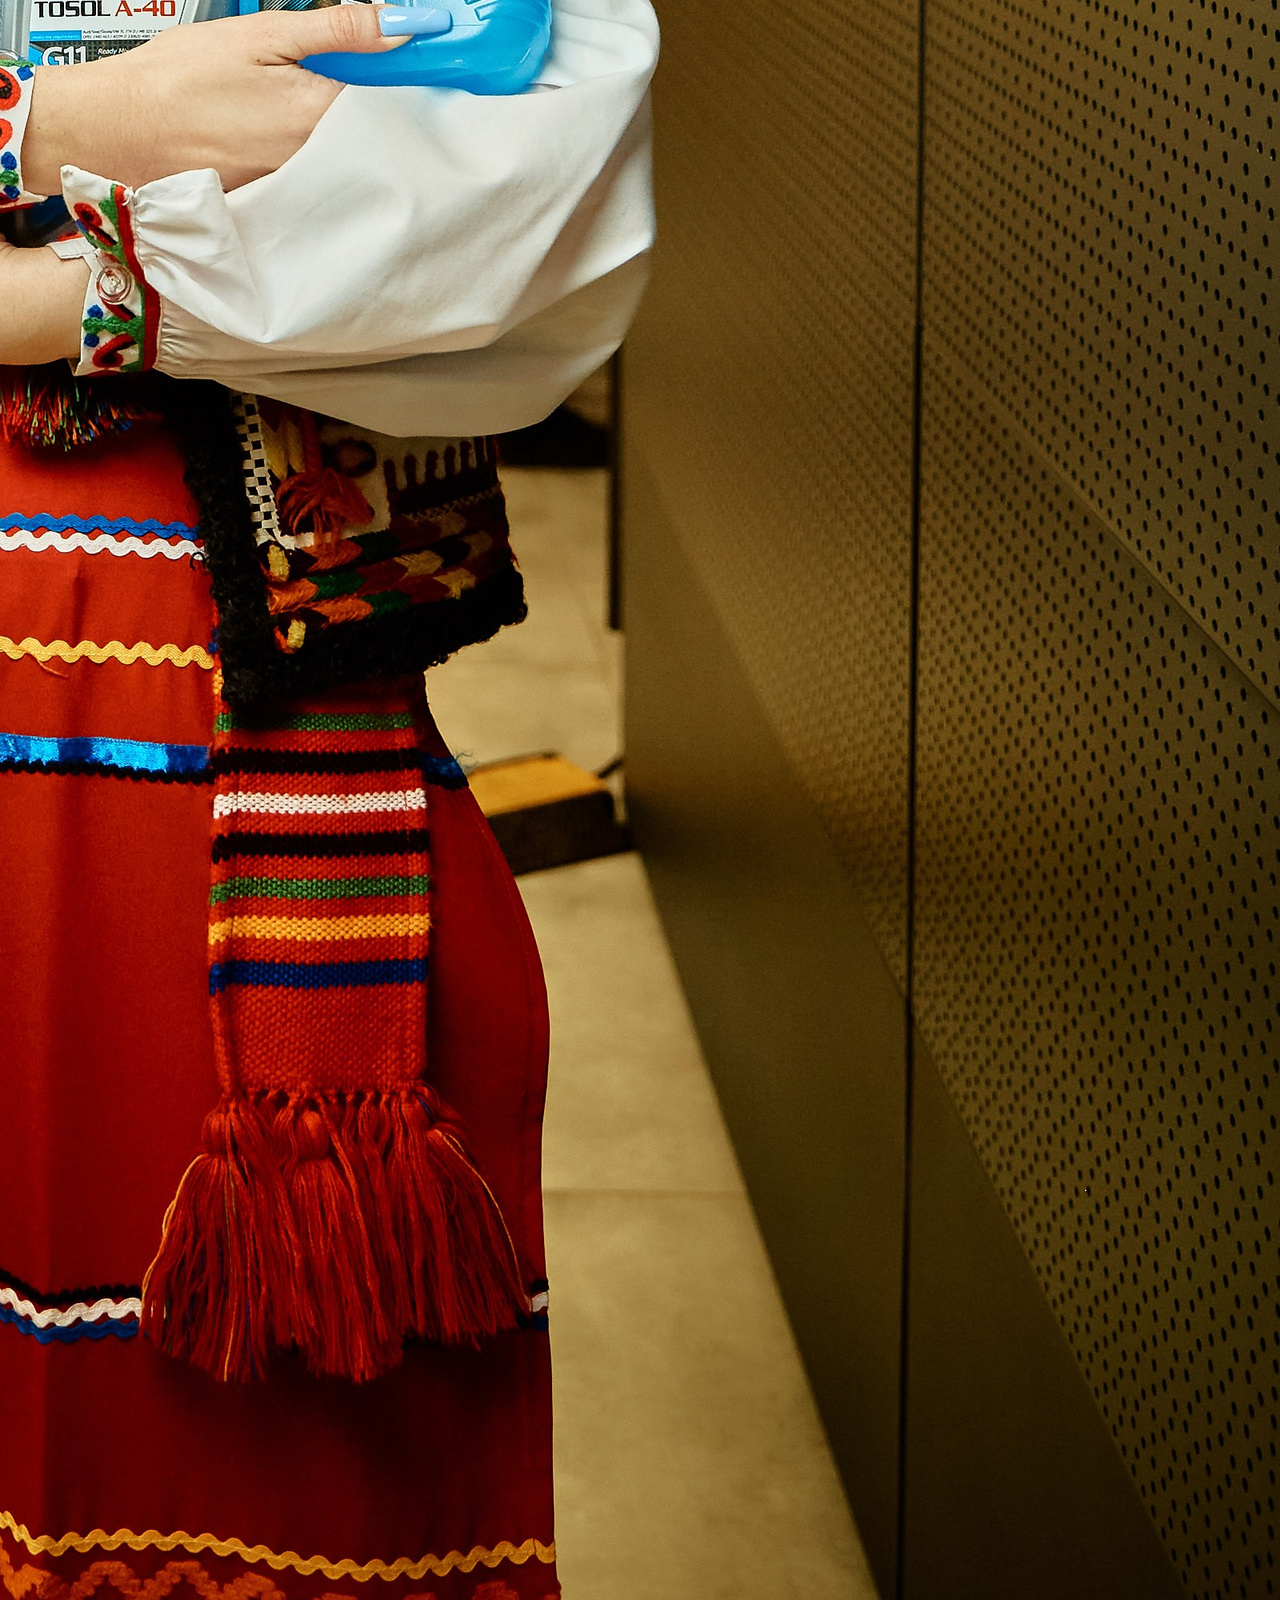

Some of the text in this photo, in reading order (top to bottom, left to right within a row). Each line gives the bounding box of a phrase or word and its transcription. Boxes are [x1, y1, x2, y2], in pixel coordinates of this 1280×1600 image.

[34, 0, 176, 18] TOSOL A-40
[42, 45, 87, 67] G11
